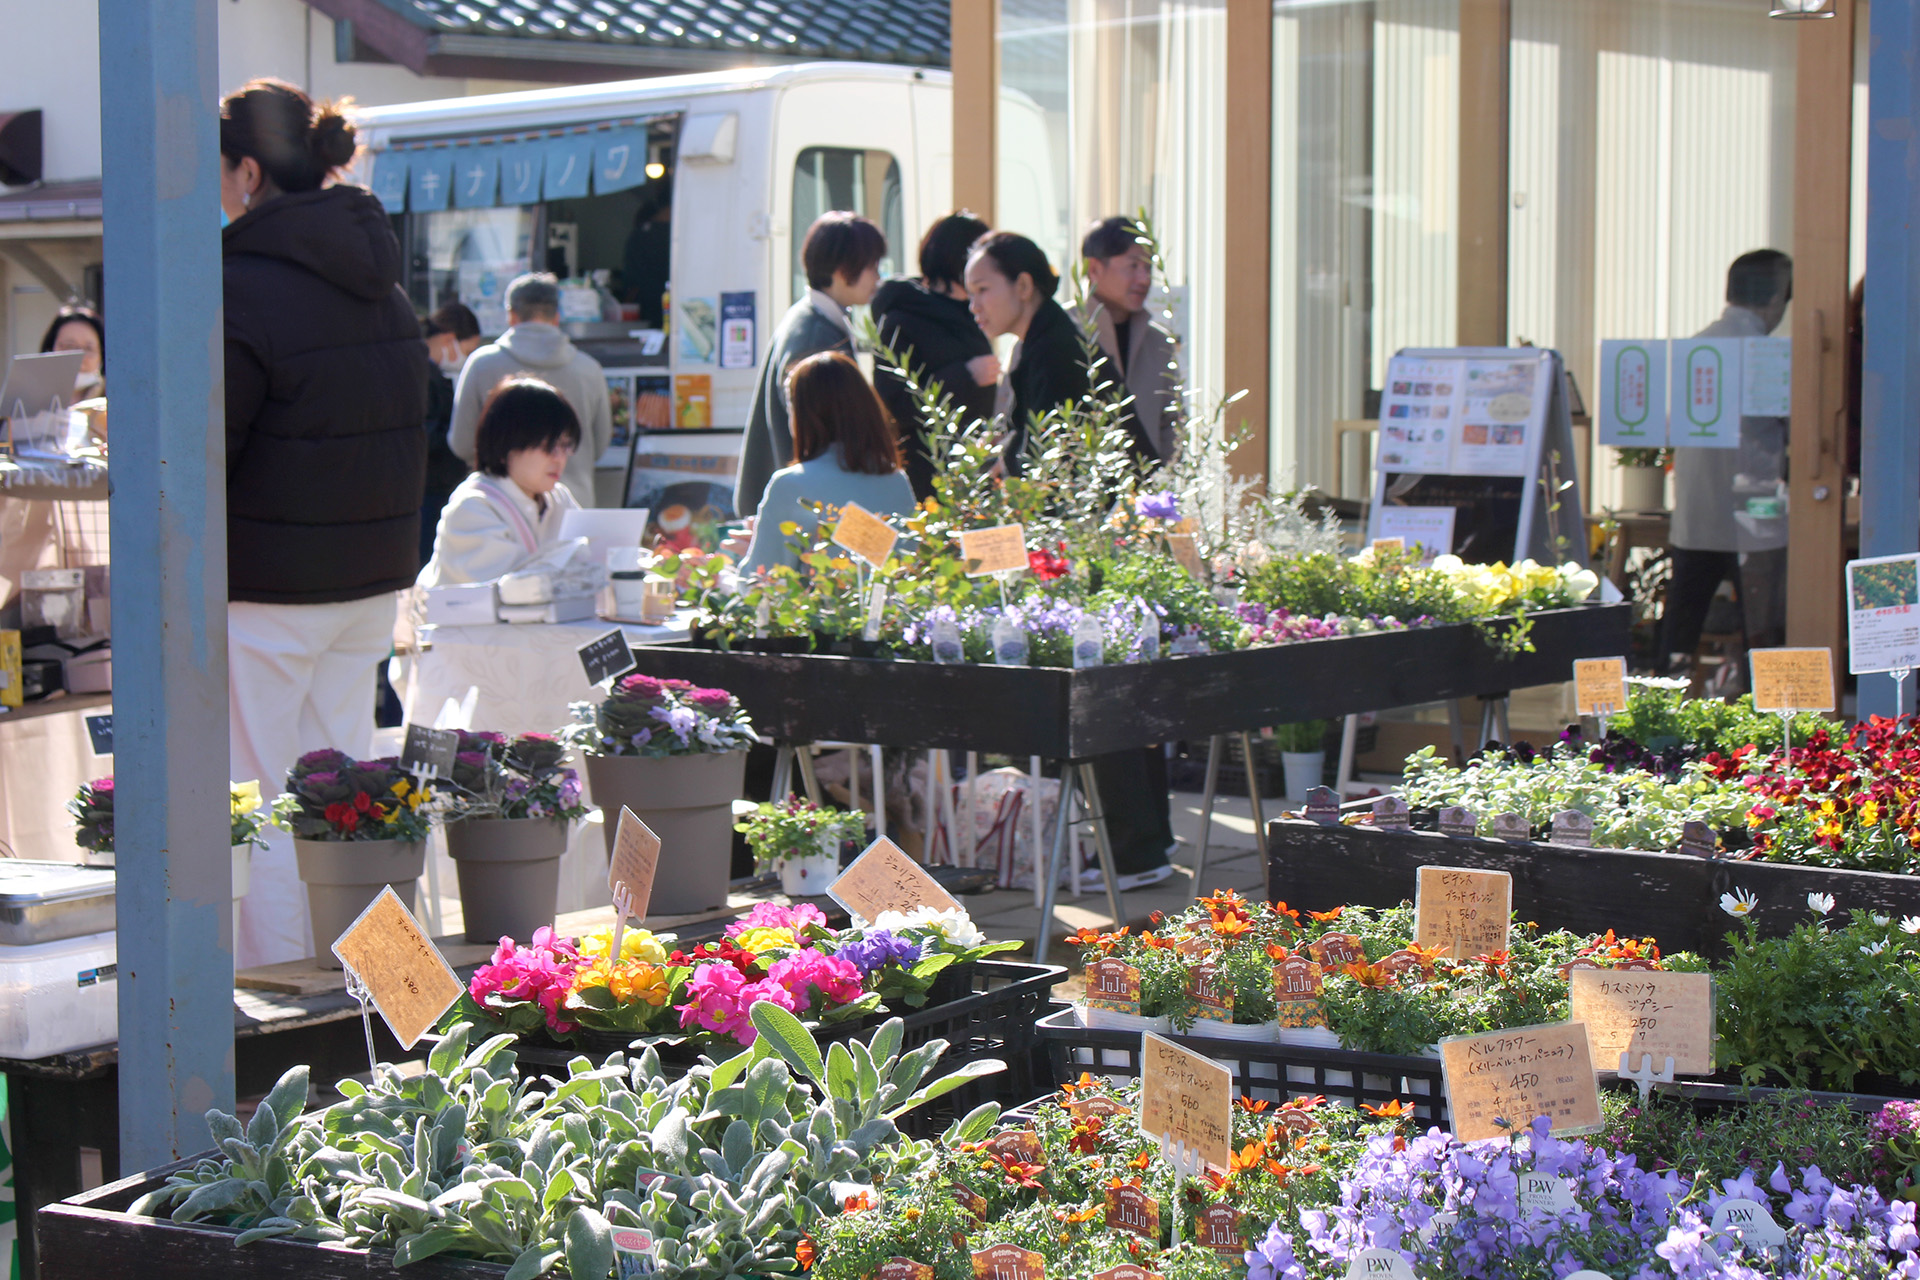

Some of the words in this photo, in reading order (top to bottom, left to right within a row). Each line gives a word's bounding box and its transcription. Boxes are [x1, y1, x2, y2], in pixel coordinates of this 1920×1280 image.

[1441, 873, 1473, 887] ビデンス
[1459, 908, 1477, 921] 560
[1325, 947, 1354, 966] JuJu
[402, 975, 420, 995] 380
[1099, 975, 1127, 994] JuJu
[1286, 975, 1312, 993] JuJu
[1599, 980, 1657, 997] カスミソウ
[1627, 998, 1674, 1013] ジプシー
[1630, 1017, 1657, 1030] 250
[1467, 1036, 1537, 1059] ベルフラワー
[1158, 1046, 1188, 1068] ビデンス
[1491, 1081, 1501, 1093] ¥
[1509, 1072, 1540, 1091] 450
[1181, 1094, 1200, 1111] 560
[1520, 1091, 1528, 1102] 6
[1168, 1103, 1174, 1113] 3
[1527, 1178, 1556, 1194] PW
[1526, 1198, 1556, 1206] WINNERS
[1119, 1203, 1147, 1228] JuJu
[1726, 1208, 1755, 1223] PW
[1210, 1224, 1239, 1245] JuJu
[1365, 1257, 1394, 1272] PW
